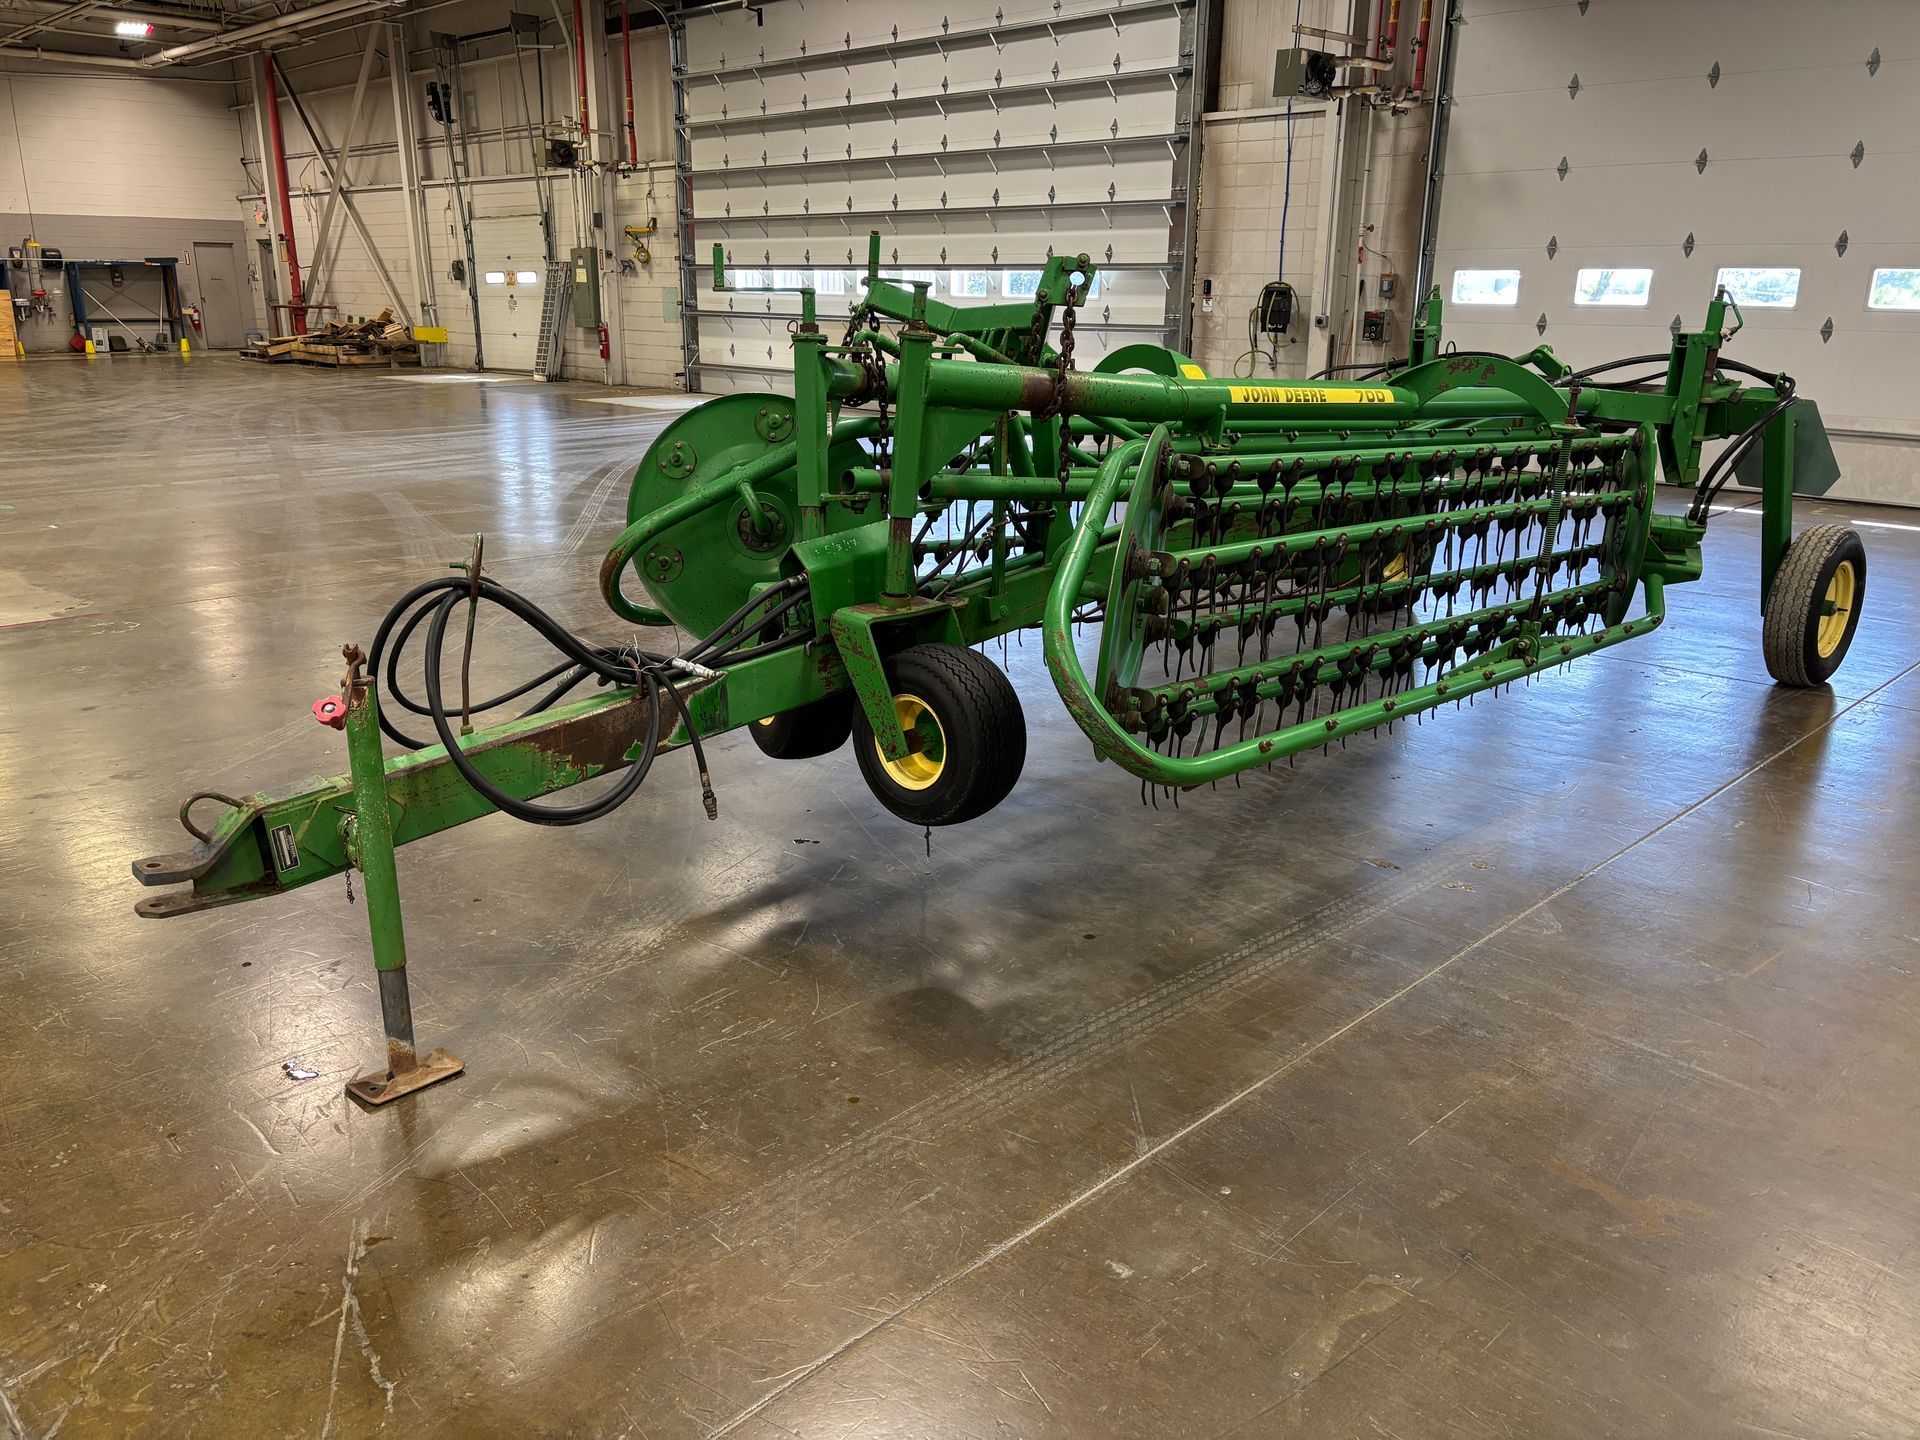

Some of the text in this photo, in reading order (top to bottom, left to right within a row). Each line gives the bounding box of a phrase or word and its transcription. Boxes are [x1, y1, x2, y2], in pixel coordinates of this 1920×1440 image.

[1242, 387, 1386, 403] JOHN DEERE 700
